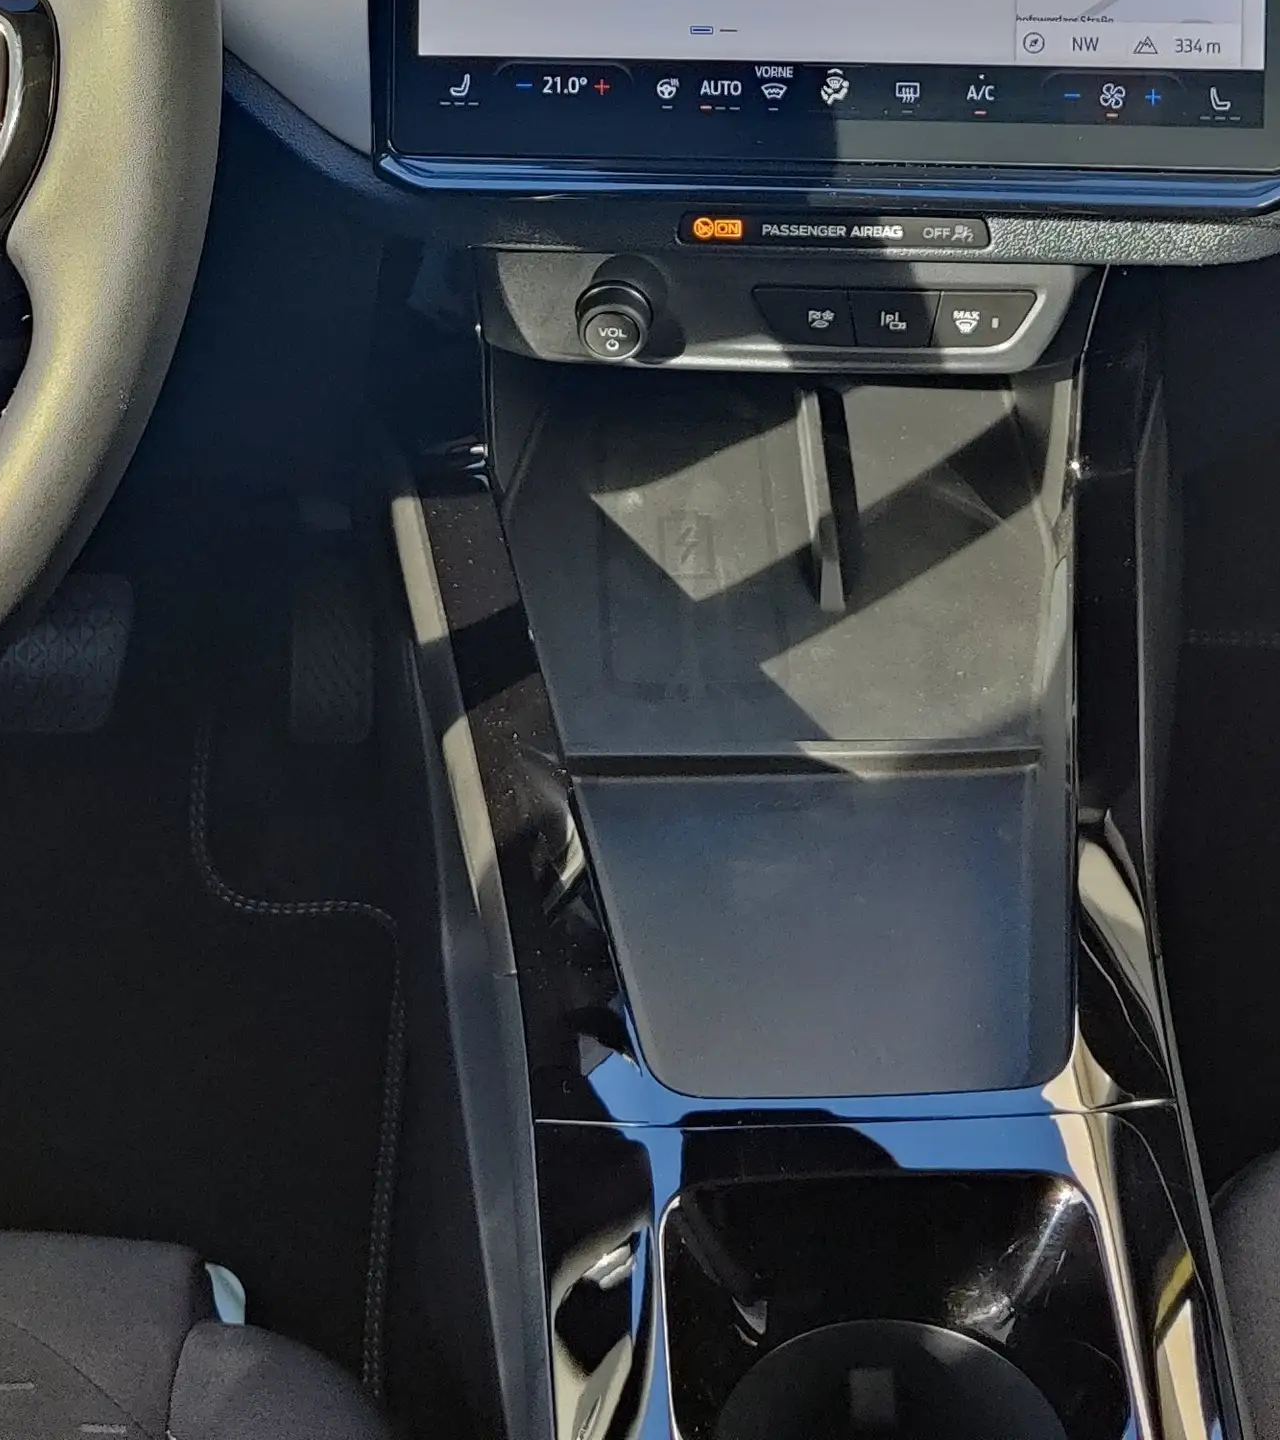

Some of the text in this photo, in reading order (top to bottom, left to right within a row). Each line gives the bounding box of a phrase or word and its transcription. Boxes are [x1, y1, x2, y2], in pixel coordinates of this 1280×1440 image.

[1072, 36, 1100, 52] NW
[1174, 38, 1221, 54] 334 m
[754, 65, 794, 78] VORNE
[542, 76, 588, 94] 21.0°
[700, 80, 742, 96] AUTO
[966, 83, 995, 102] A/C
[717, 222, 739, 235] ON
[762, 224, 904, 238] PASSENGER AIRBAG
[922, 227, 951, 239] OFF
[953, 309, 981, 320] MAX
[597, 327, 628, 338] VOL
